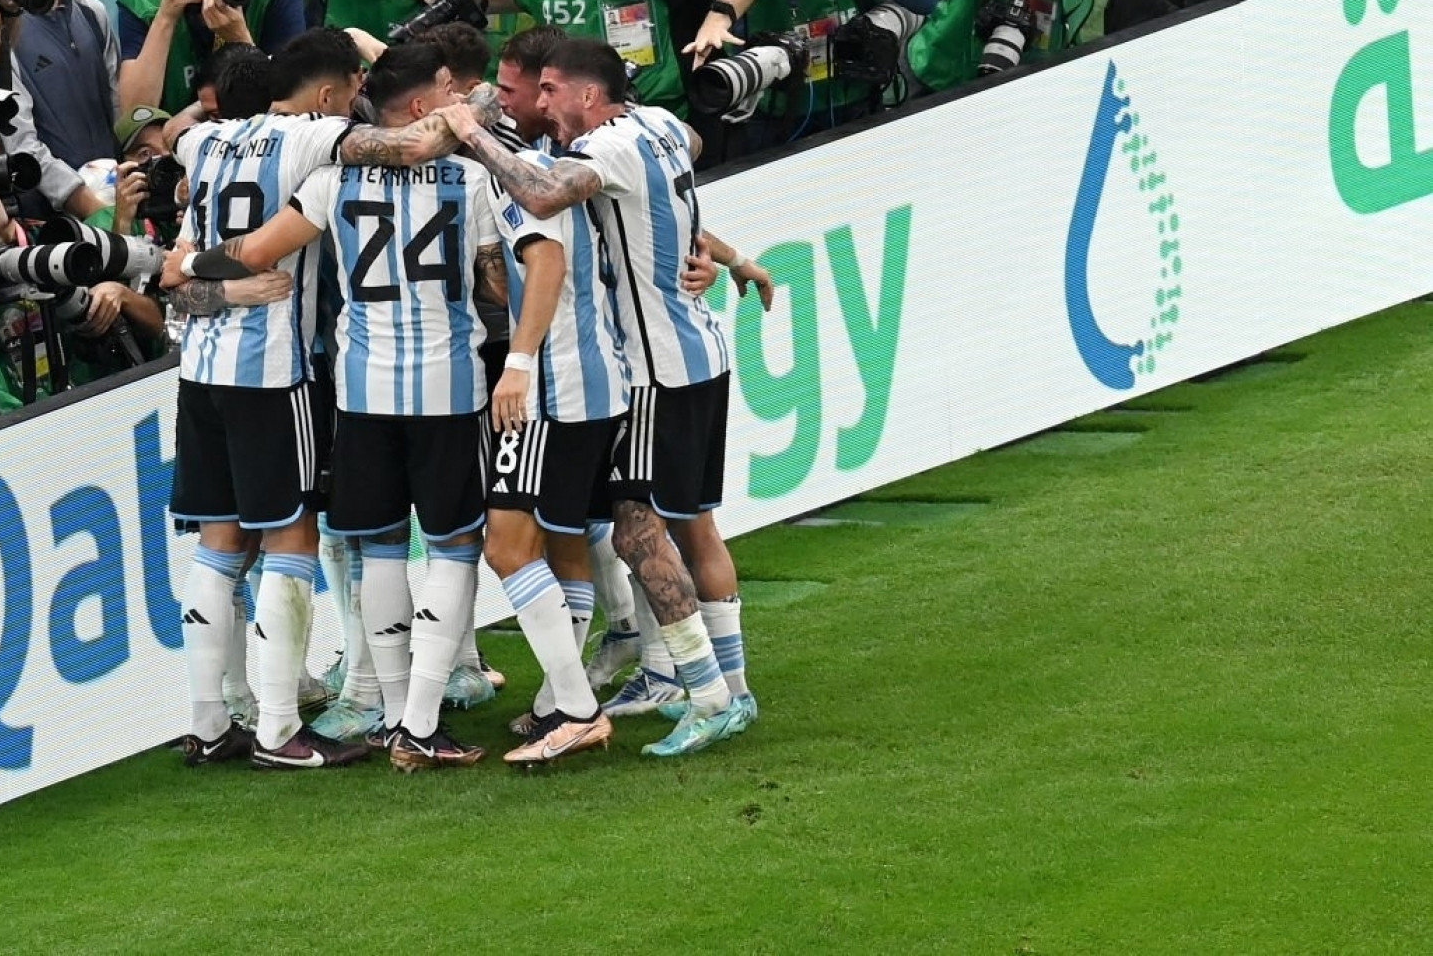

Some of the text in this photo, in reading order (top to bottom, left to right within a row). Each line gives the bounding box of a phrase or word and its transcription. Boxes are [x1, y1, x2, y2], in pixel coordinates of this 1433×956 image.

[340, 199, 464, 303] 24
[706, 202, 913, 502] gy
[495, 428, 520, 474] 8
